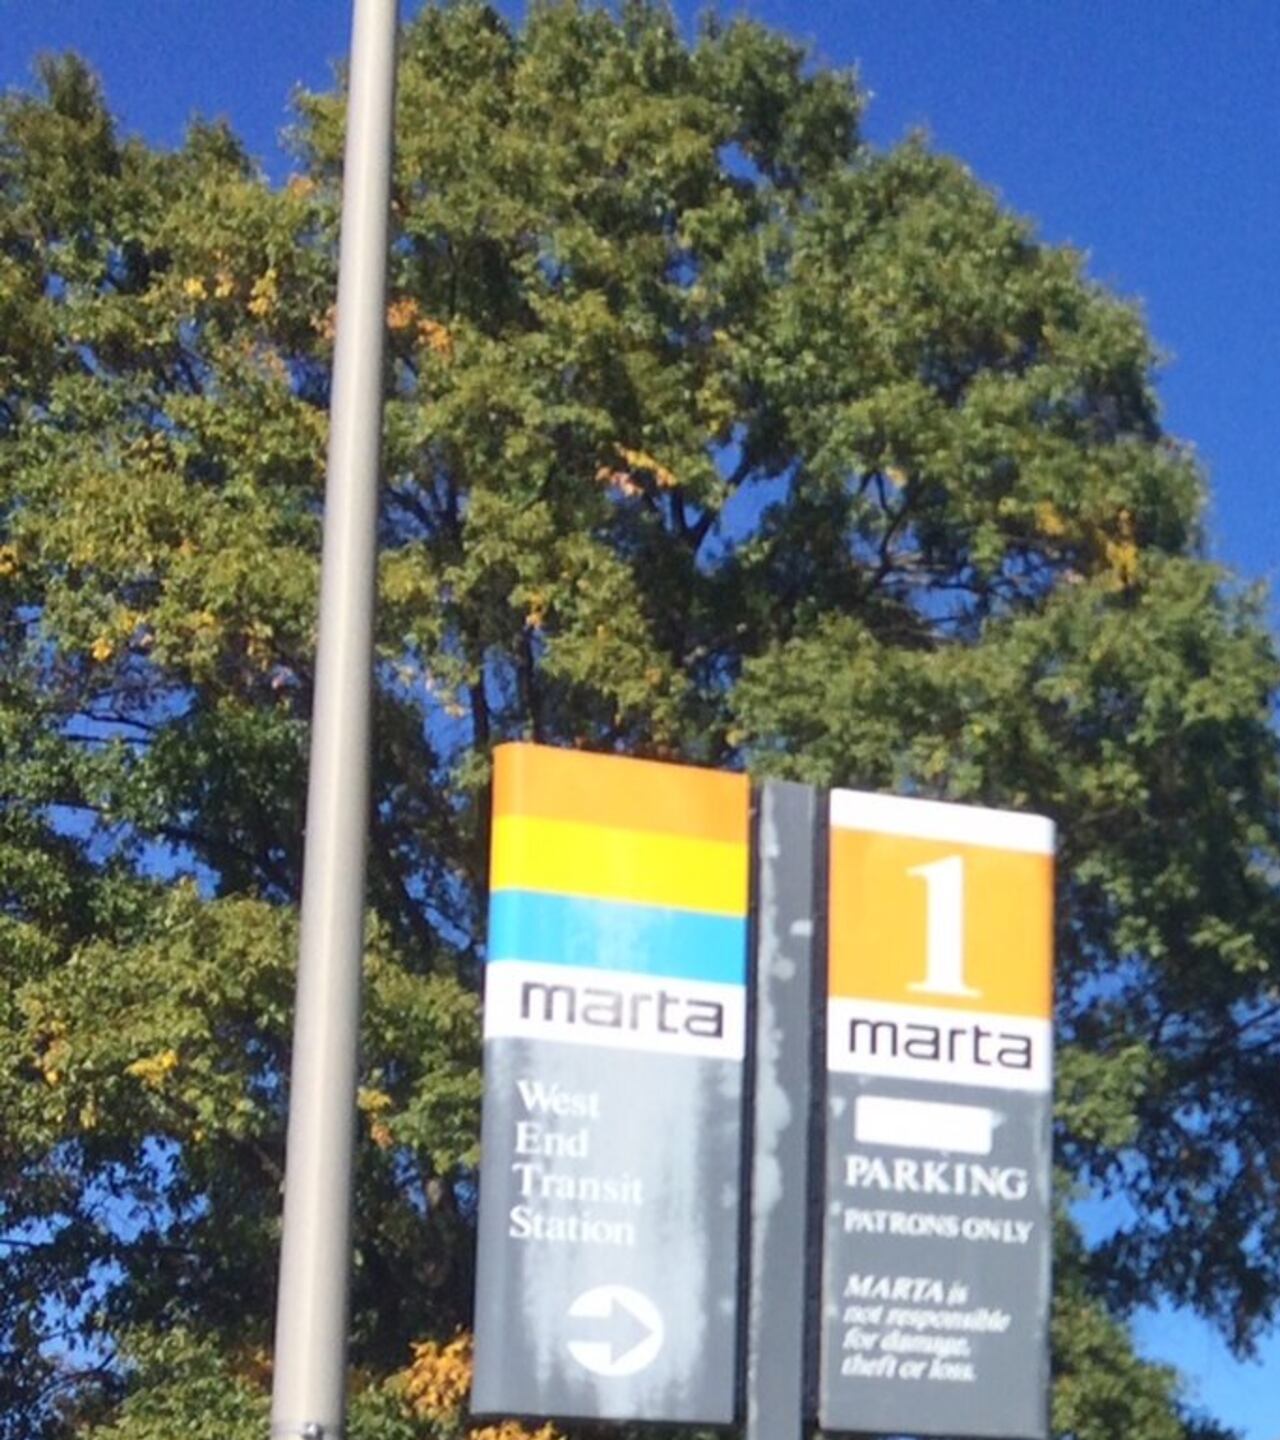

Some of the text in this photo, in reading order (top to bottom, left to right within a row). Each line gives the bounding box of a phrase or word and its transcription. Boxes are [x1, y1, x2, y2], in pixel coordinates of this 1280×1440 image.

[905, 854, 984, 998] 1
[520, 981, 724, 1038] marta
[849, 1018, 1032, 1070] marta
[516, 1079, 600, 1118] West
[515, 1121, 589, 1158] End
[511, 1163, 642, 1205] Transit
[845, 1155, 1028, 1200] PARKING
[509, 1205, 634, 1246] Station
[844, 1208, 1034, 1244] PATRONS ONLY
[844, 1274, 943, 1303] MARTA
